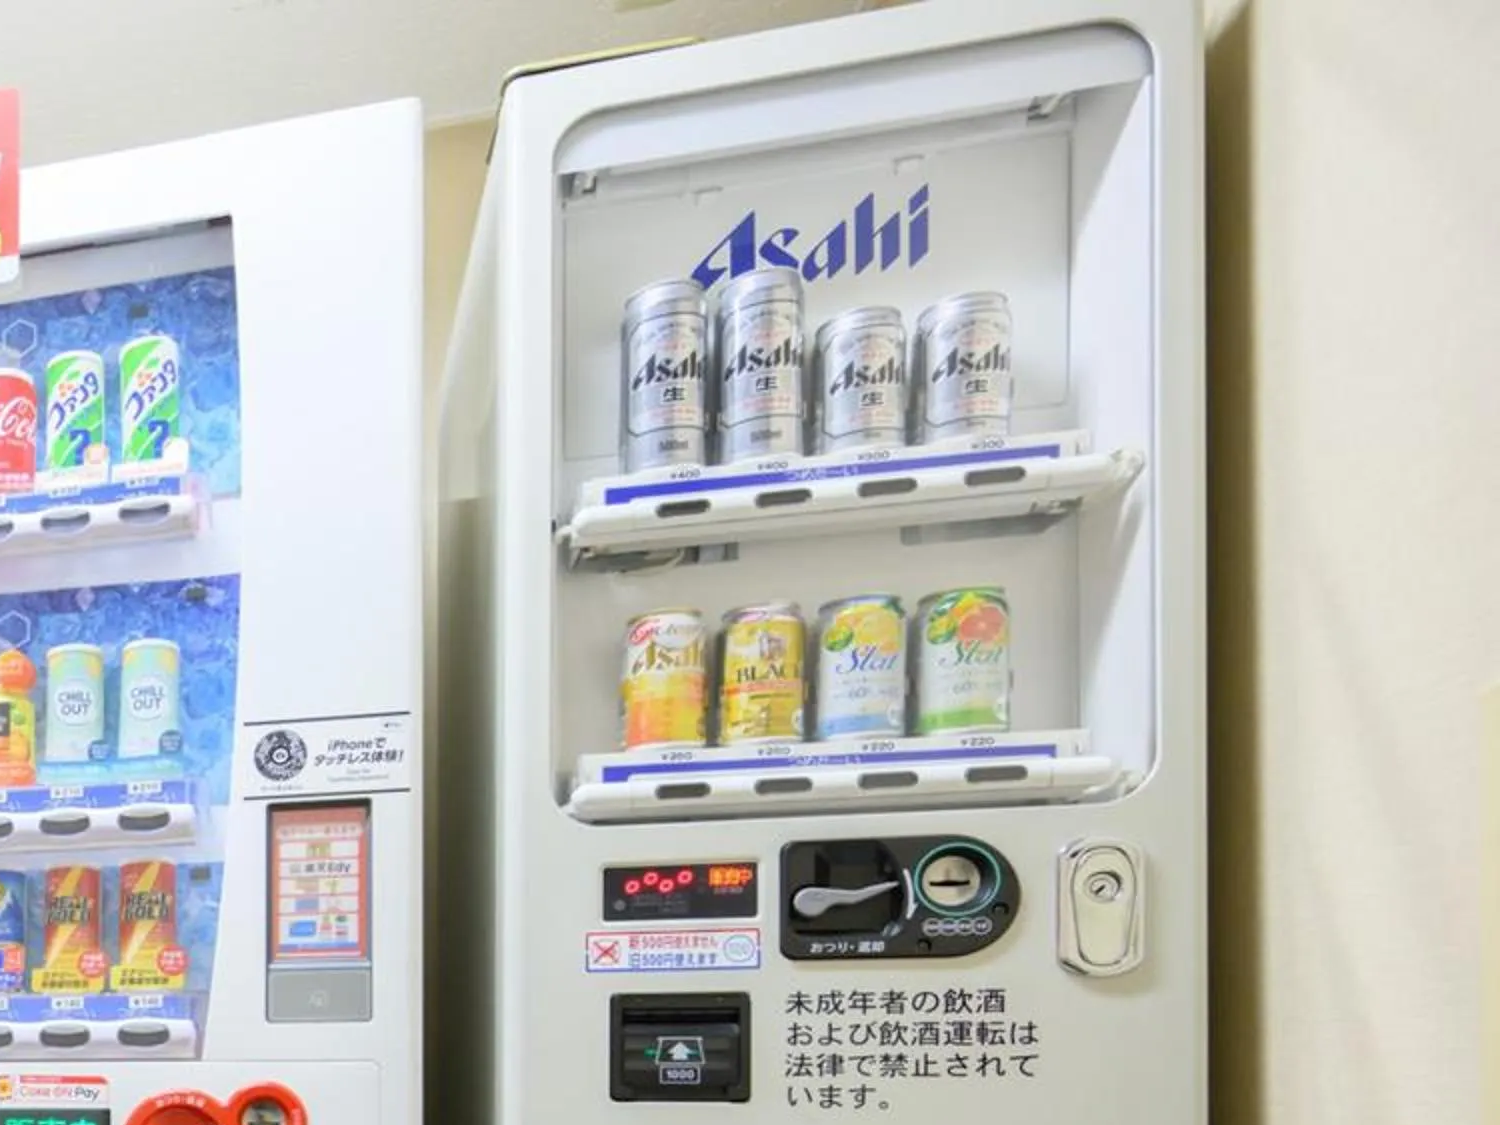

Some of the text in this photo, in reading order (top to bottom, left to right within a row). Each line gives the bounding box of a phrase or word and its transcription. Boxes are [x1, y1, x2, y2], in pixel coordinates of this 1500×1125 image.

[690, 184, 930, 290] Asahi
[58, 689, 92, 704] CHILL
[131, 684, 165, 699] CHILL
[60, 703, 90, 716] OUT
[133, 697, 163, 711] OUT
[327, 737, 387, 752] iPhoneで
[786, 988, 1006, 1015] 未成年者の飲酒
[787, 1020, 1039, 1047] および飲酒運転は
[785, 1052, 1039, 1078] 法律で禁止されて
[74, 1087, 100, 1102] Pay
[787, 1083, 890, 1110] います。
